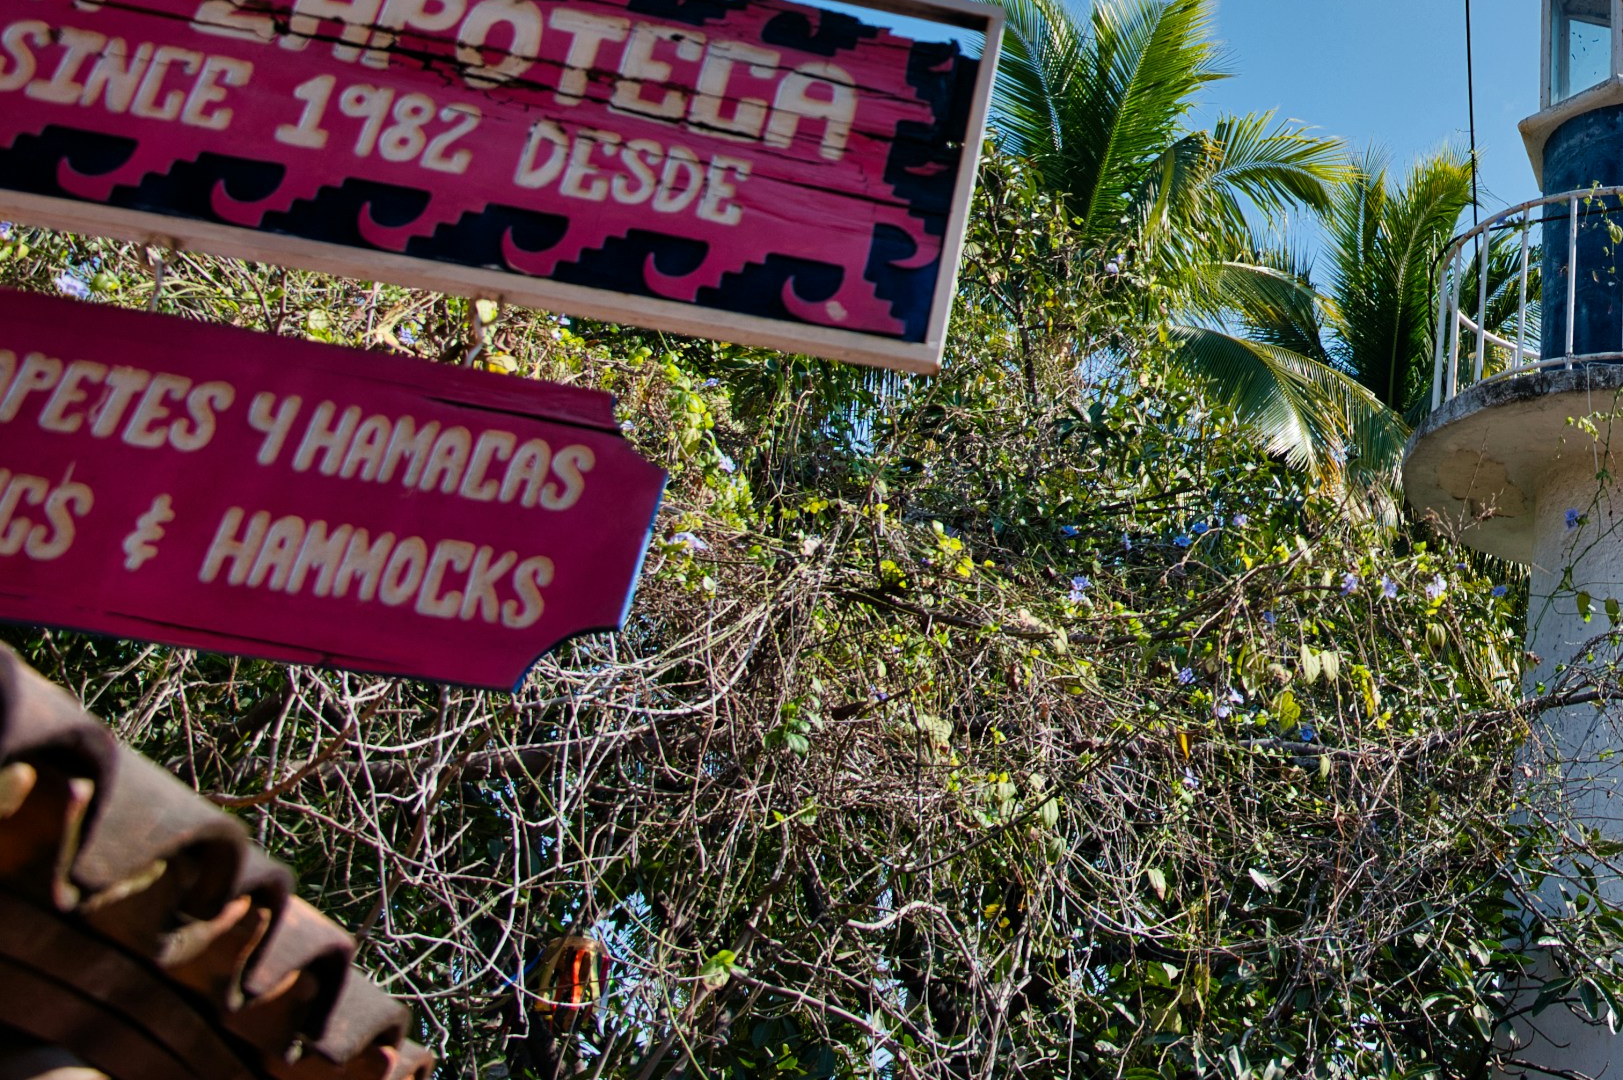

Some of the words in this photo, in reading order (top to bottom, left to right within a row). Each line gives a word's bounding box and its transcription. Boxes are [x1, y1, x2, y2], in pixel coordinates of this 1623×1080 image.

[0, 21, 255, 131] SINCE
[275, 74, 483, 174] 1982
[513, 120, 754, 227] DESDE
[292, 400, 597, 512] HAMACAS
[0, 465, 95, 561] GS
[198, 506, 556, 630] HAMMOCKS
